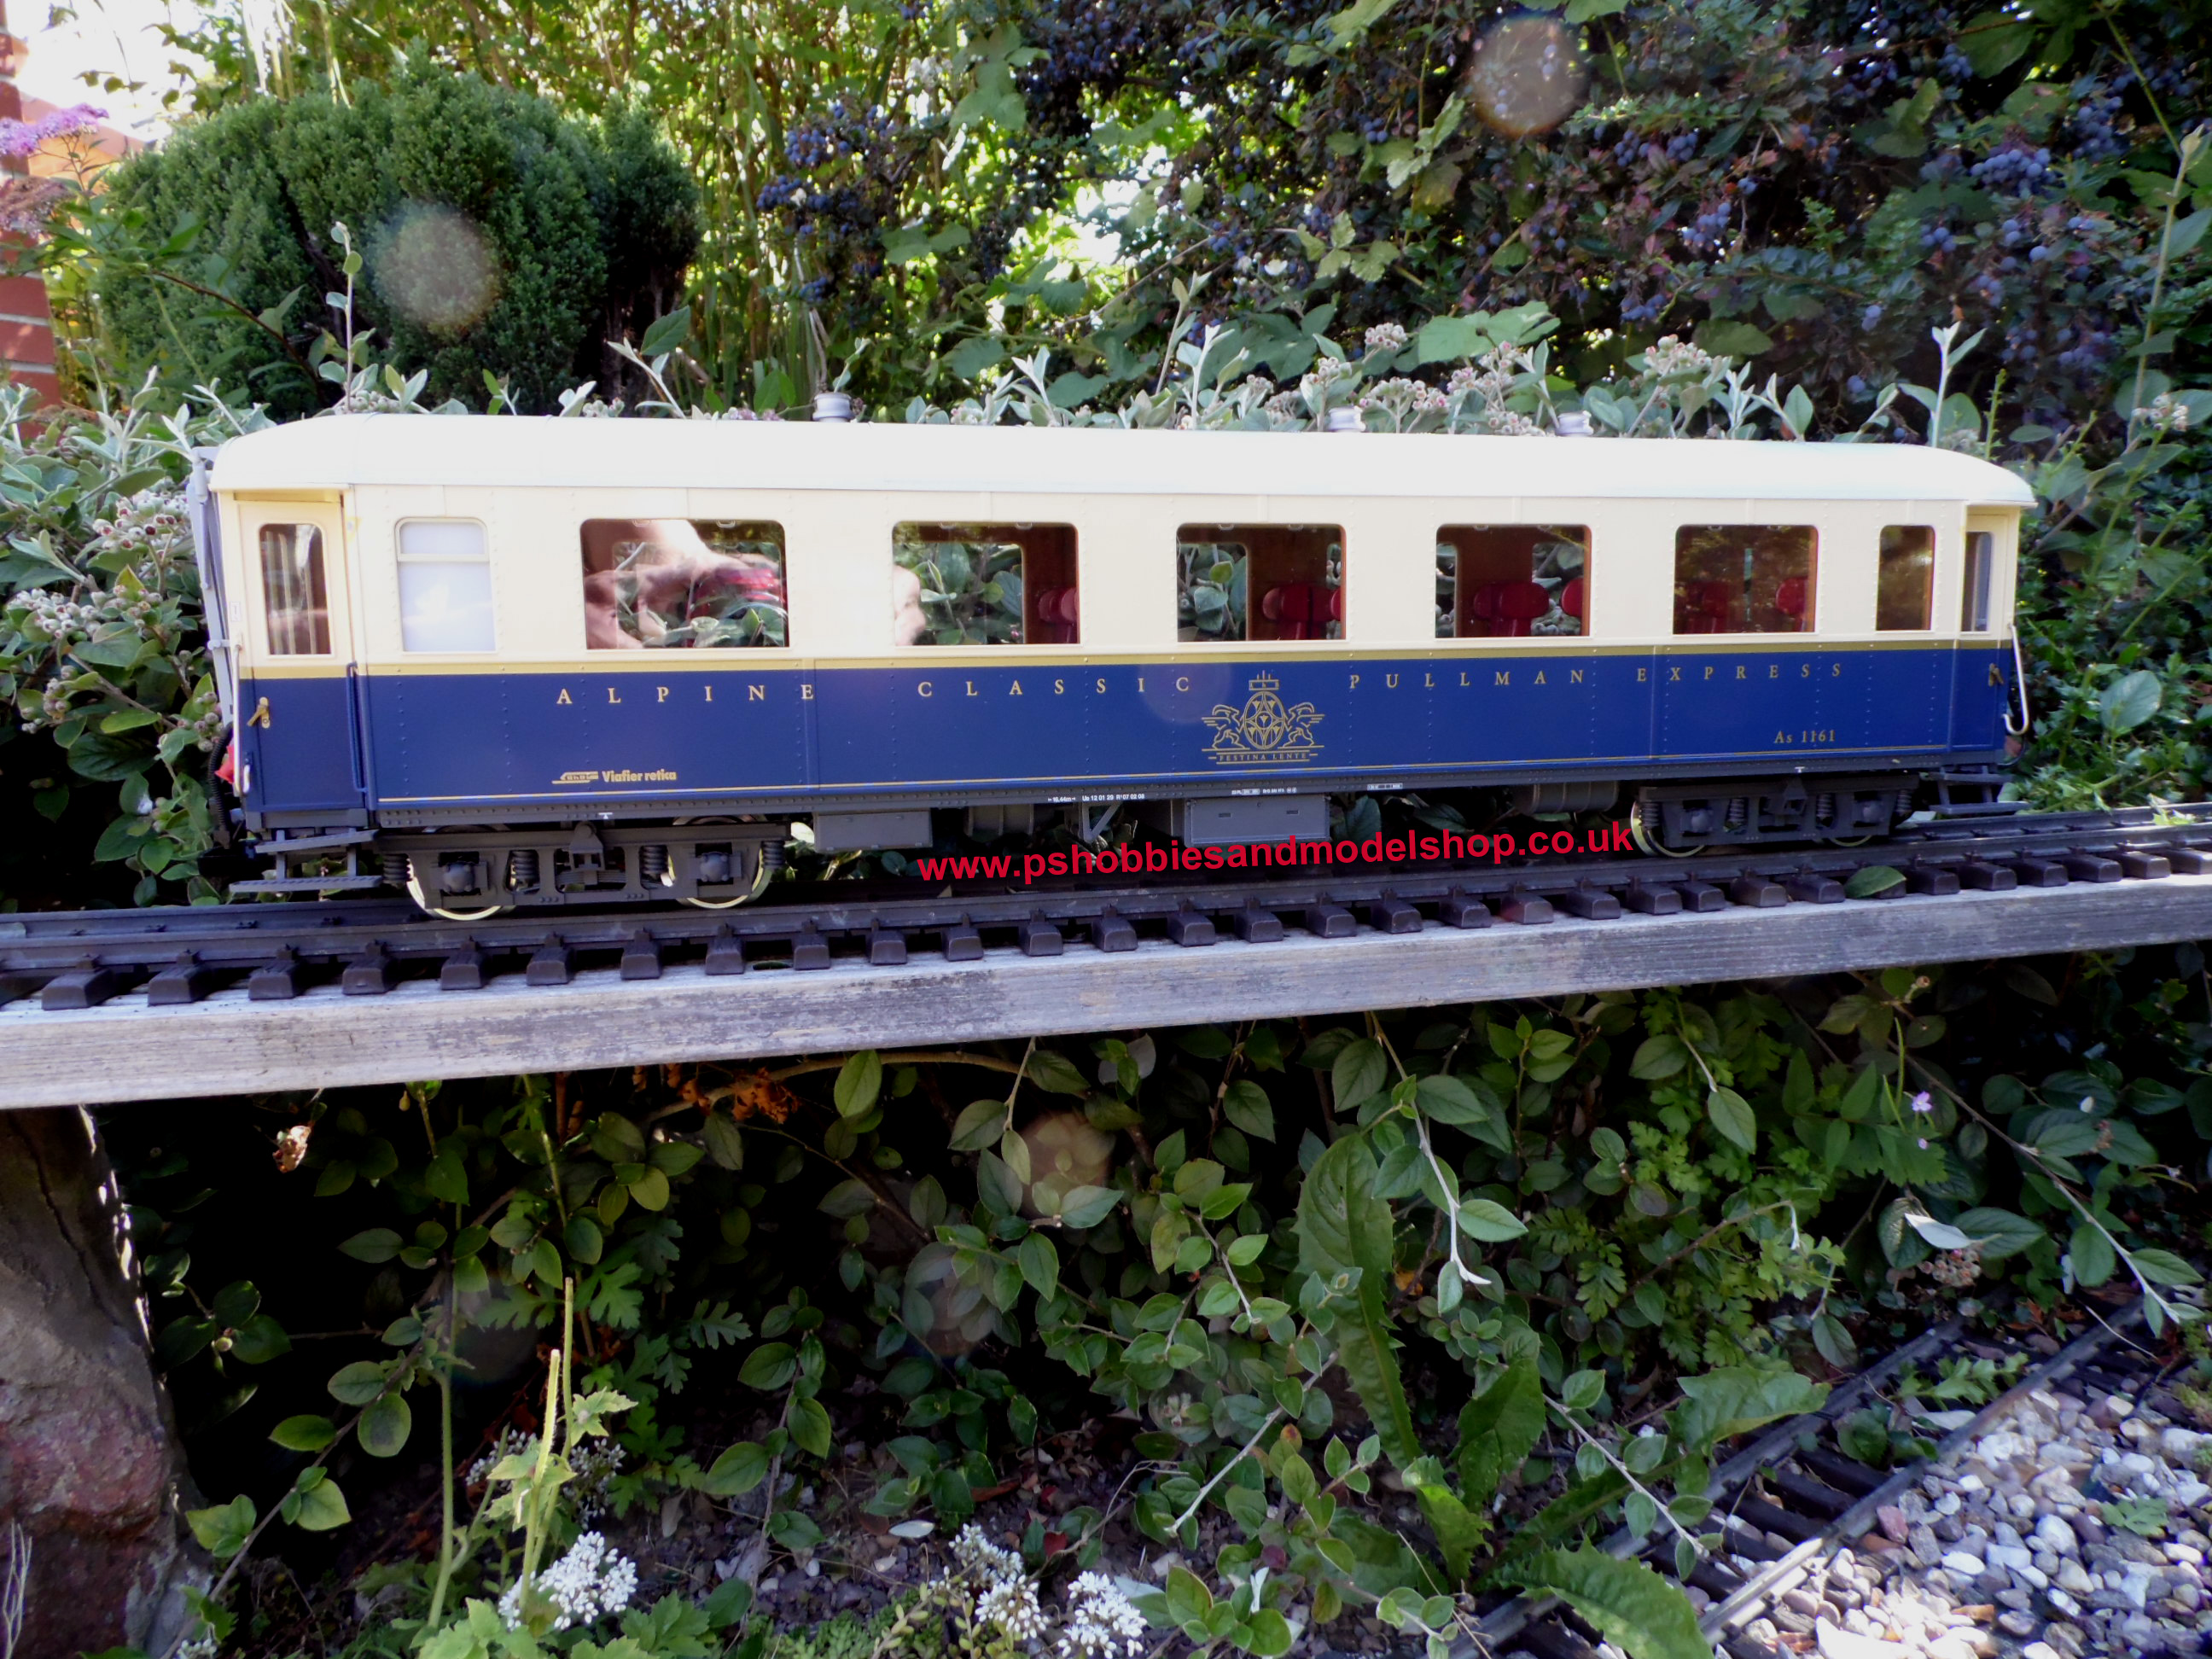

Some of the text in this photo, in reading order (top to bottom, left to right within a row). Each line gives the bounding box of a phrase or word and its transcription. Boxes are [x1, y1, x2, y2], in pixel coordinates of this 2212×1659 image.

[556, 663, 1841, 704] ALPINE CLASSIC PULLMAN EXPRESS
[1773, 729, 1836, 743] As 1161
[1272, 752, 1306, 760] LENTE
[602, 769, 643, 783] Viafier
[644, 768, 677, 781] retica
